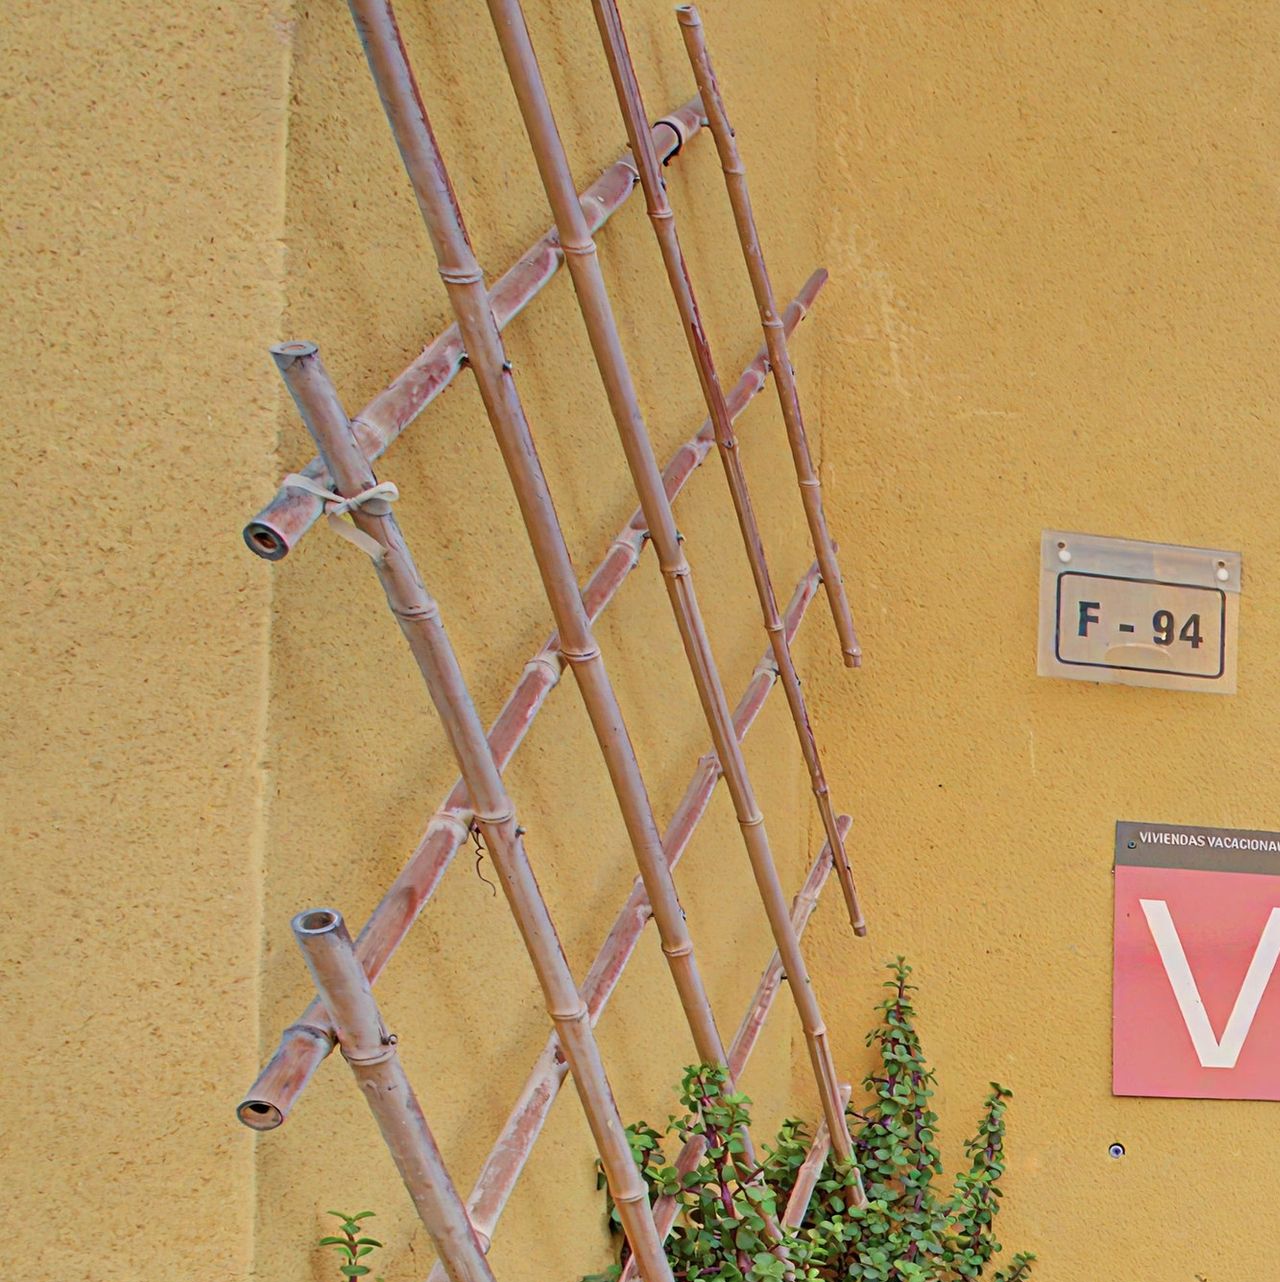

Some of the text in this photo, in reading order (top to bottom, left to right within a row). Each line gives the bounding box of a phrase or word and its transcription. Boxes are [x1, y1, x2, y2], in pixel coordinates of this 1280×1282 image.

[1078, 601, 1101, 637] F
[1152, 609, 1204, 649] 94
[1139, 831, 1205, 847] VIVIENDAS
